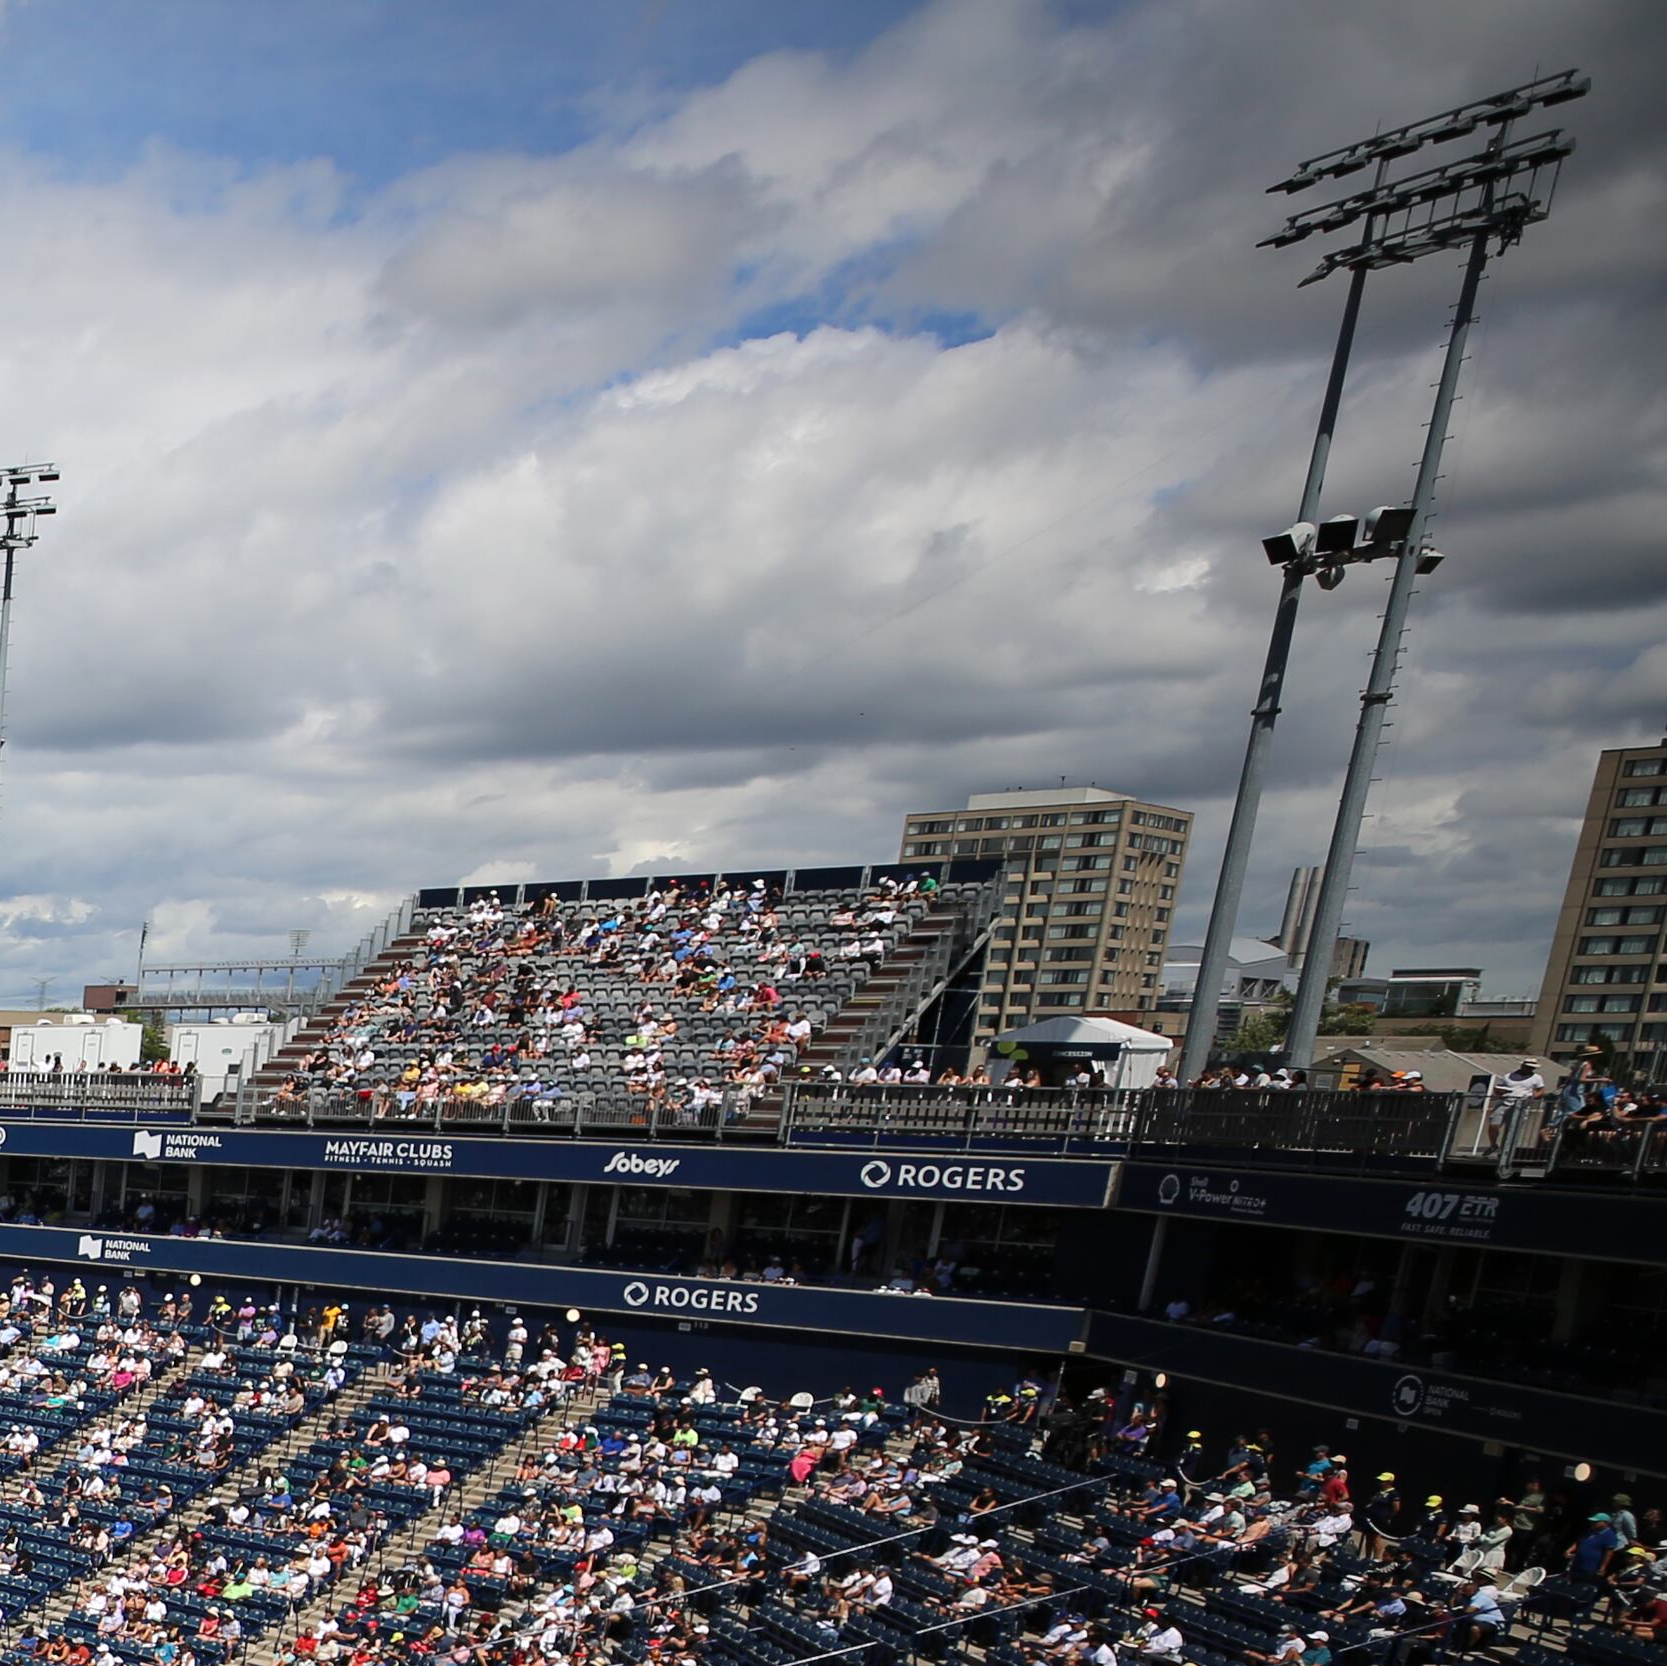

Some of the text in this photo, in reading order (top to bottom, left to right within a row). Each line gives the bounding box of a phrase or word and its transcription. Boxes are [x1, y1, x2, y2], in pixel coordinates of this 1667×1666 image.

[166, 1134, 221, 1147] NATIONAL
[165, 1146, 197, 1158] BANK
[325, 1141, 453, 1159] MAYFAIR CLUBS
[325, 1155, 452, 1167] FITNESS TENNIS SQUASH
[604, 1151, 680, 1178] Sobeys
[898, 1164, 1025, 1192] ROGERS
[1188, 1188, 1232, 1206] V-Power
[1404, 1191, 1500, 1219] 407 ETR
[104, 1250, 131, 1260] BANK
[105, 1240, 151, 1253] NATIONAL
[654, 1285, 759, 1313] ROGERS
